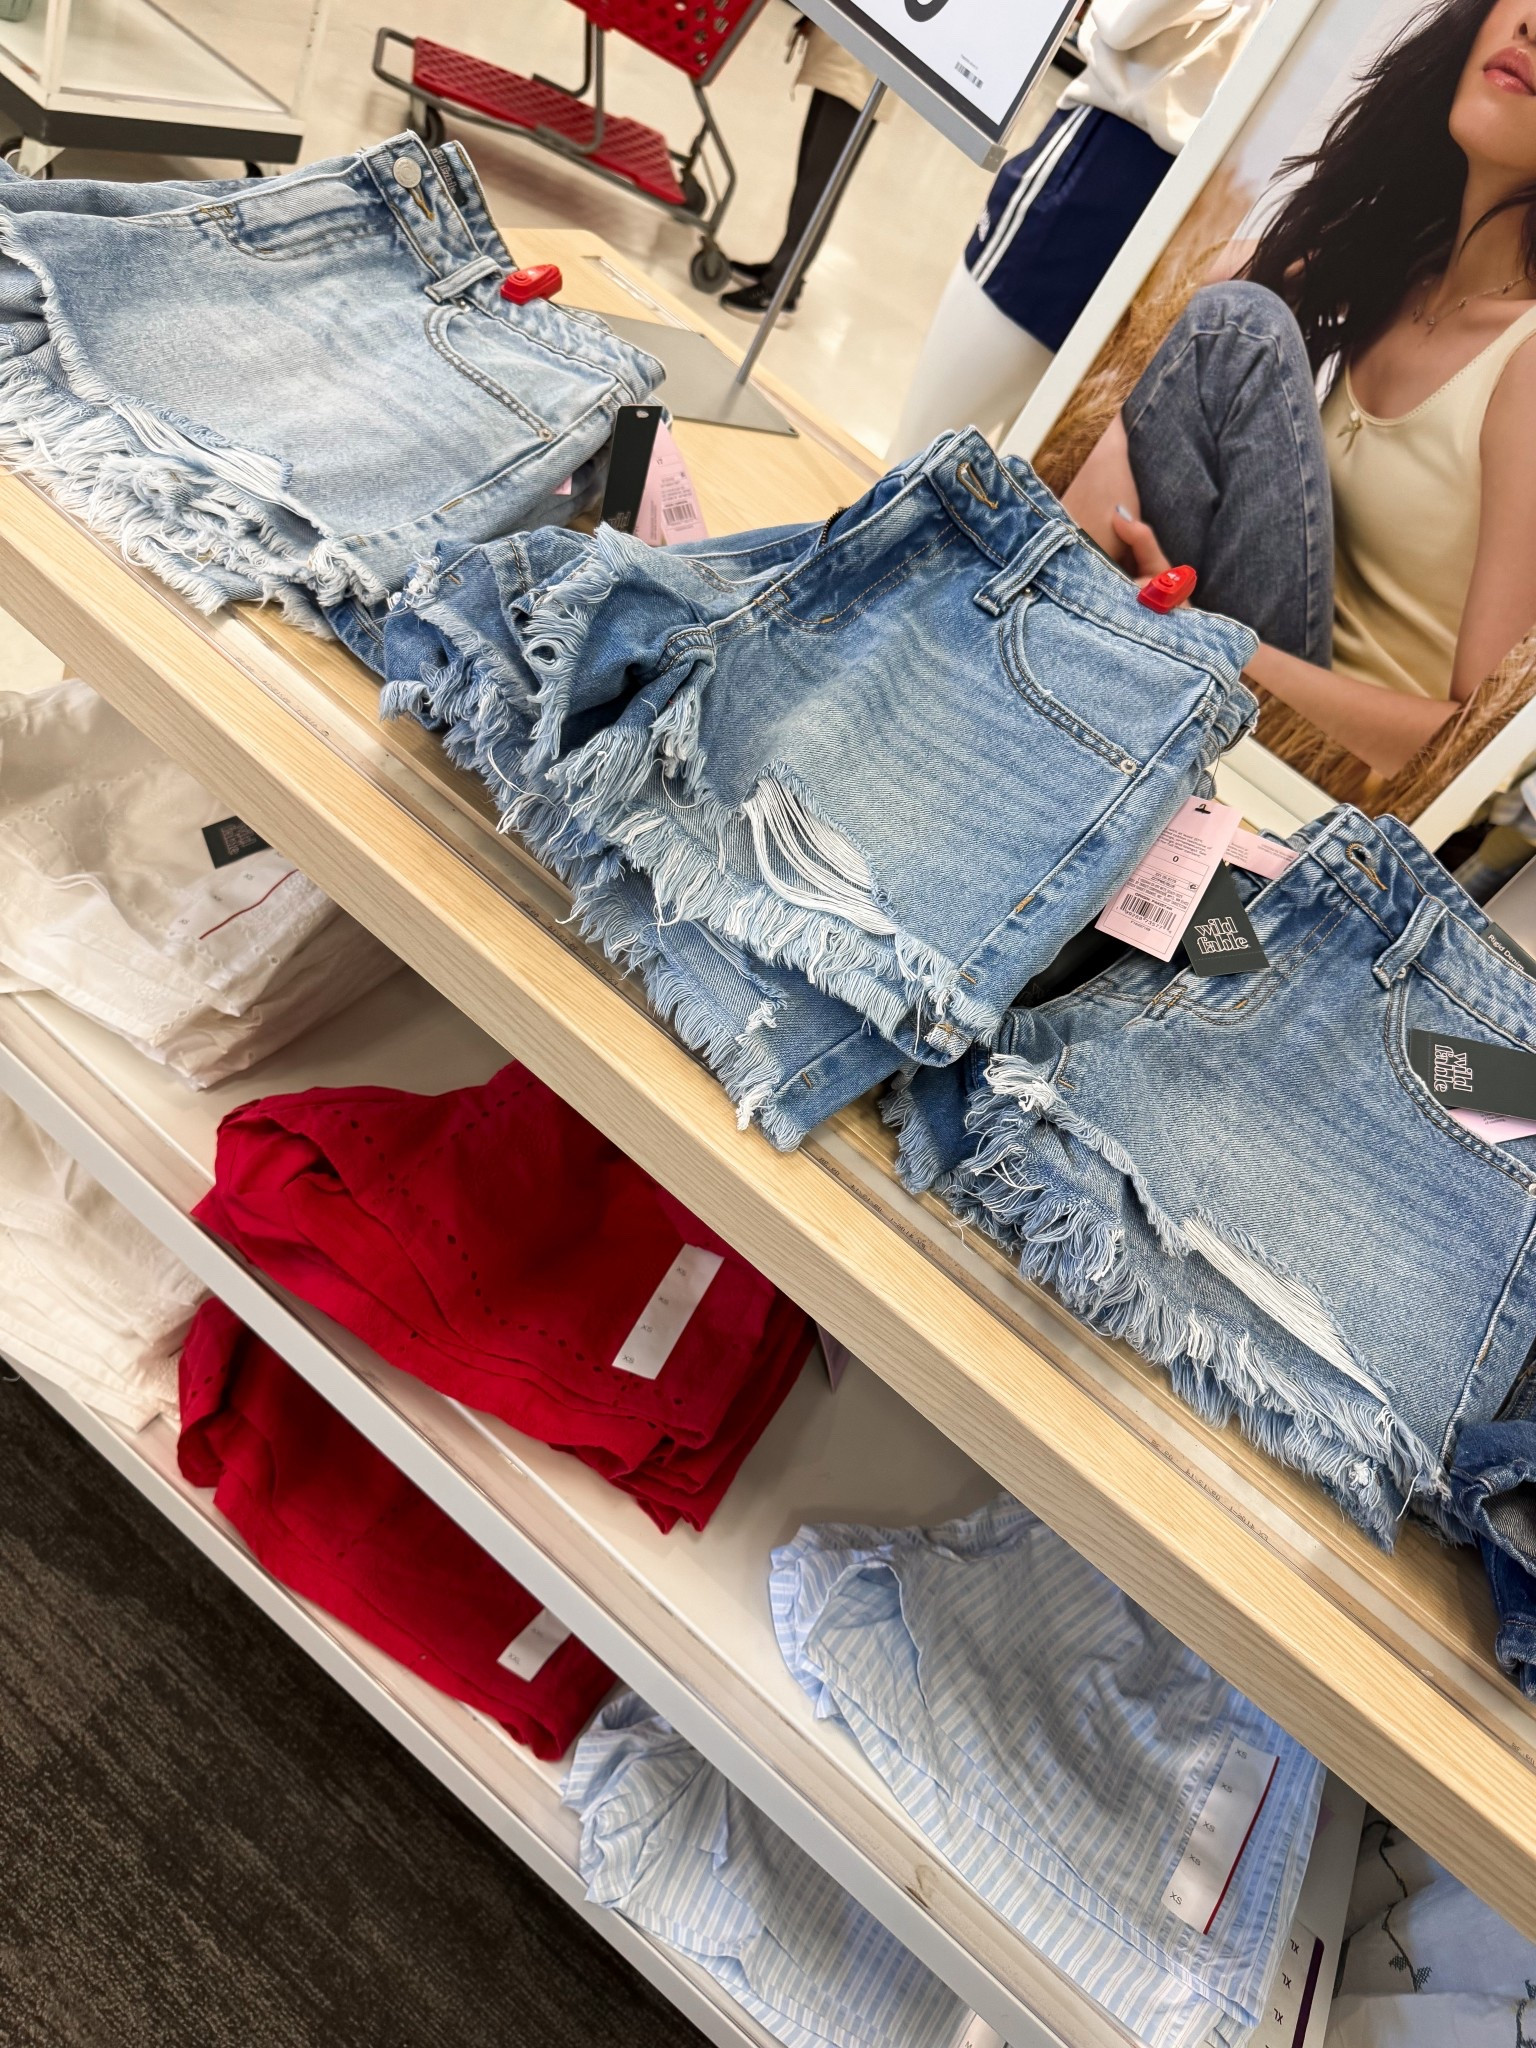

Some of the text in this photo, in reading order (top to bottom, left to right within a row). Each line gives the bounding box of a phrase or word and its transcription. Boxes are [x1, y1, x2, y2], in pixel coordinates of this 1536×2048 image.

[1194, 917, 1238, 936] wild
[1197, 934, 1249, 955] fable
[1488, 934, 1505, 951] Rigid
[1434, 1044, 1454, 1092] fable
[1453, 1052, 1473, 1092] wild
[1235, 1748, 1247, 1760] XS
[1221, 1783, 1233, 1794] XS
[1203, 1821, 1215, 1833] XS
[1189, 1854, 1201, 1866] XS
[1170, 1891, 1183, 1905] XS
[1290, 1939, 1299, 1955] XL
[1282, 1973, 1292, 1989] XL
[1274, 2008, 1284, 2025] XL
